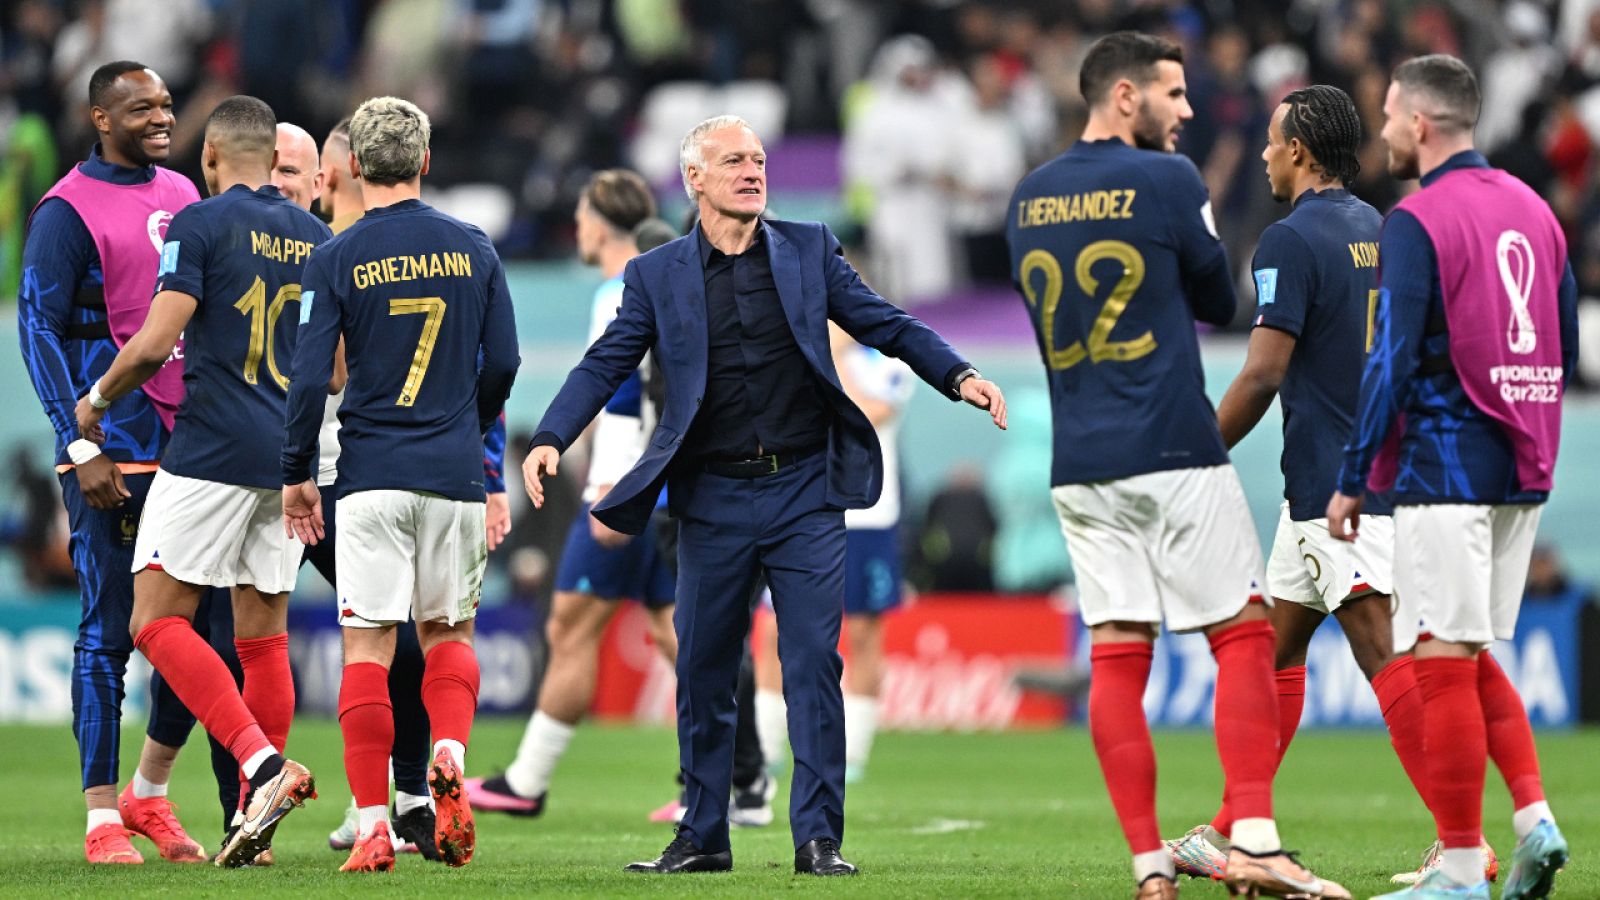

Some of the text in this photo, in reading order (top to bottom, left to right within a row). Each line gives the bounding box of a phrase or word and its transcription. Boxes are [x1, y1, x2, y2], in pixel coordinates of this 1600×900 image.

[1018, 190, 1136, 228] T.HERNANDEZ
[353, 252, 472, 290] GRIEZMANN
[1020, 240, 1158, 370] 22
[233, 275, 302, 392] 10
[389, 297, 447, 407] 7
